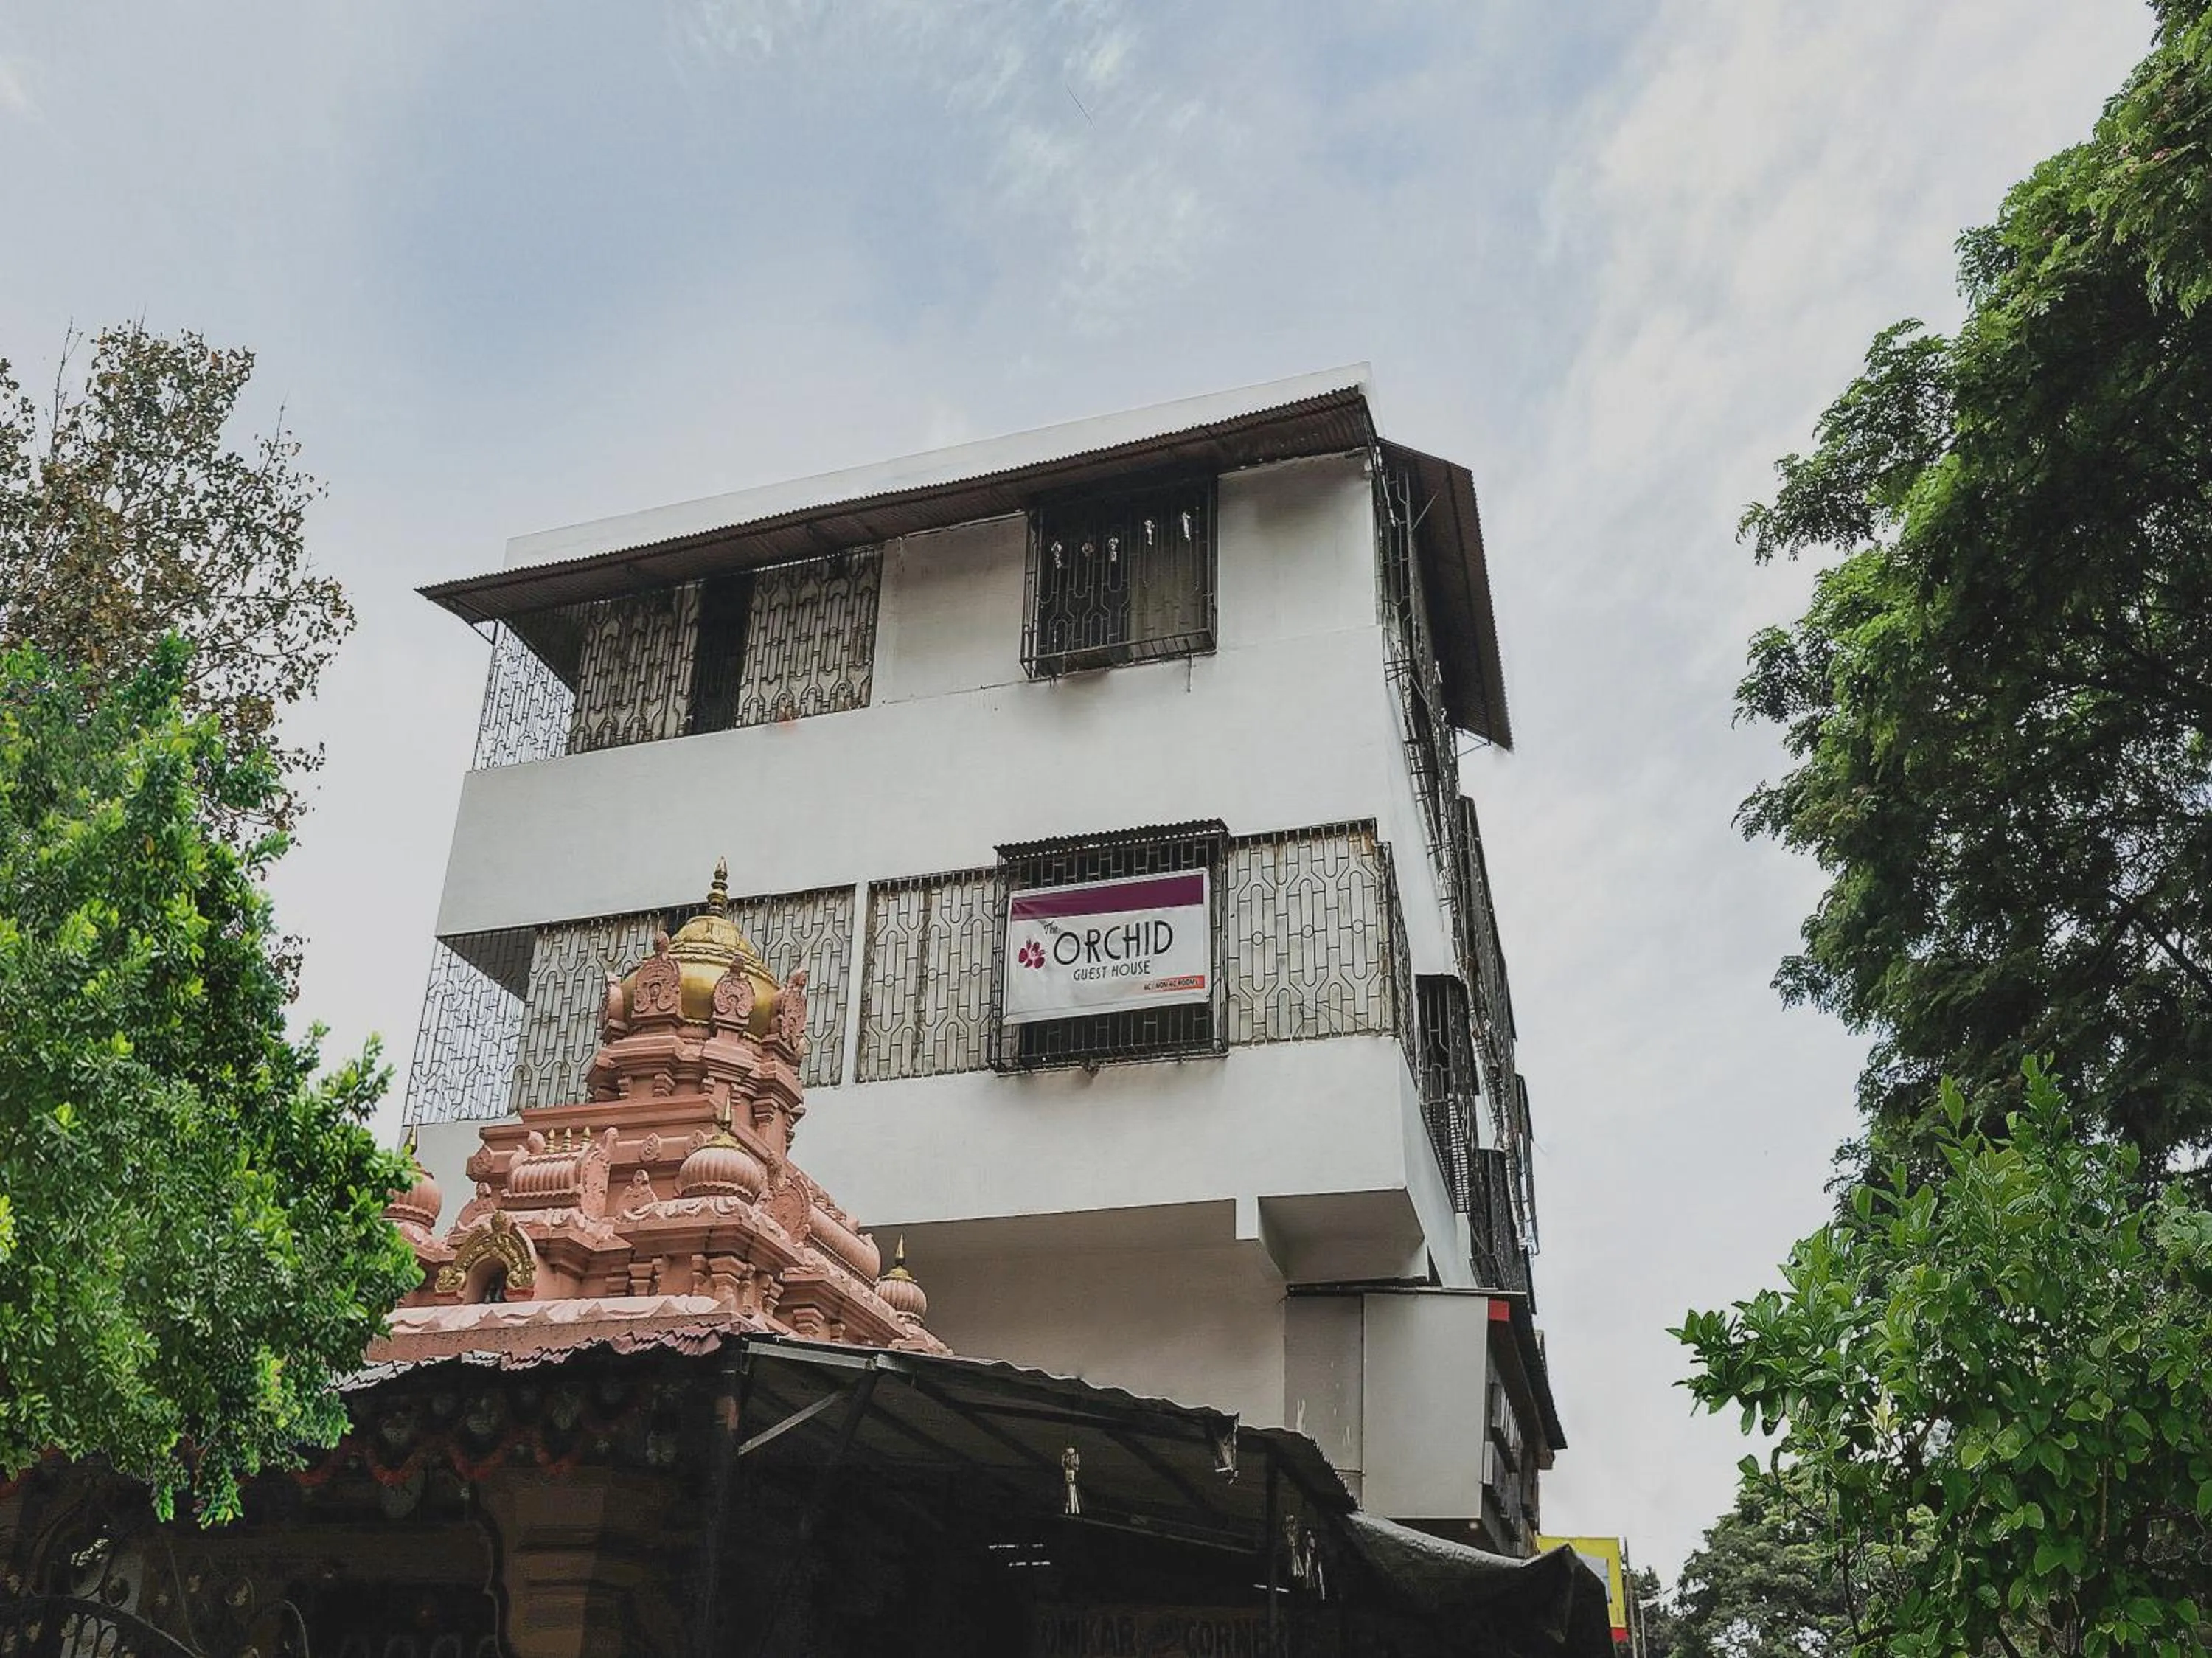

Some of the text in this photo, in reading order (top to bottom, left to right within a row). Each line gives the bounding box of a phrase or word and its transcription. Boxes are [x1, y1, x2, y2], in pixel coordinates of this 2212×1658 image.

[1054, 920, 1173, 965] ORCHID
[1073, 960, 1151, 981] GUEST HOUSE
